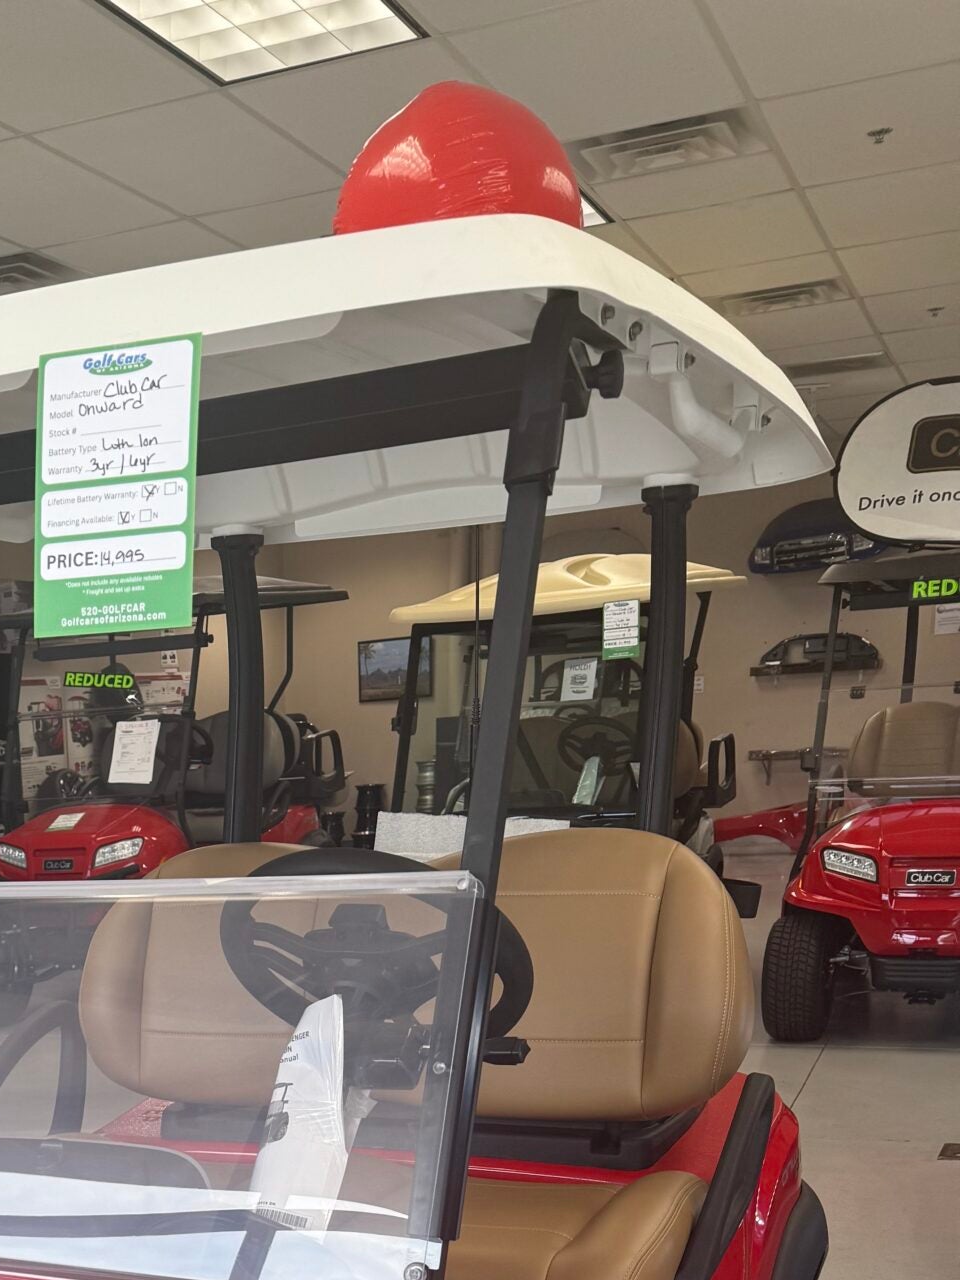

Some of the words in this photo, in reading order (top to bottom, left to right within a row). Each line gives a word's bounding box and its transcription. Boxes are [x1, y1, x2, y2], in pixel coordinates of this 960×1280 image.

[83, 353, 113, 369] Golf
[117, 353, 147, 364] Cars
[50, 388, 102, 402] Manufacturer
[103, 380, 137, 398] Club
[141, 374, 167, 392] Car
[49, 410, 74, 419] Model
[78, 393, 144, 417] Onward
[49, 429, 69, 438] Stock
[48, 445, 76, 456] Battery
[79, 444, 97, 454] Type
[48, 465, 83, 476] Warranty
[90, 457, 114, 476] 3yr
[47, 497, 76, 506] Lifetime
[77, 494, 102, 504] Battery
[104, 490, 138, 501] Warranty:
[859, 494, 906, 511] Drive
[912, 489, 924, 504] it
[47, 517, 79, 528] Financing
[81, 514, 114, 525] Available:
[47, 551, 98, 570] PRICE:
[100, 549, 145, 567] 14,995
[912, 579, 960, 599] RED
[81, 603, 145, 616] 520-GOLFCAR
[61, 611, 166, 627] Golfcarsofarizona.com
[64, 672, 134, 689] REDUCED
[910, 873, 932, 883] Club
[933, 873, 951, 883] Car
